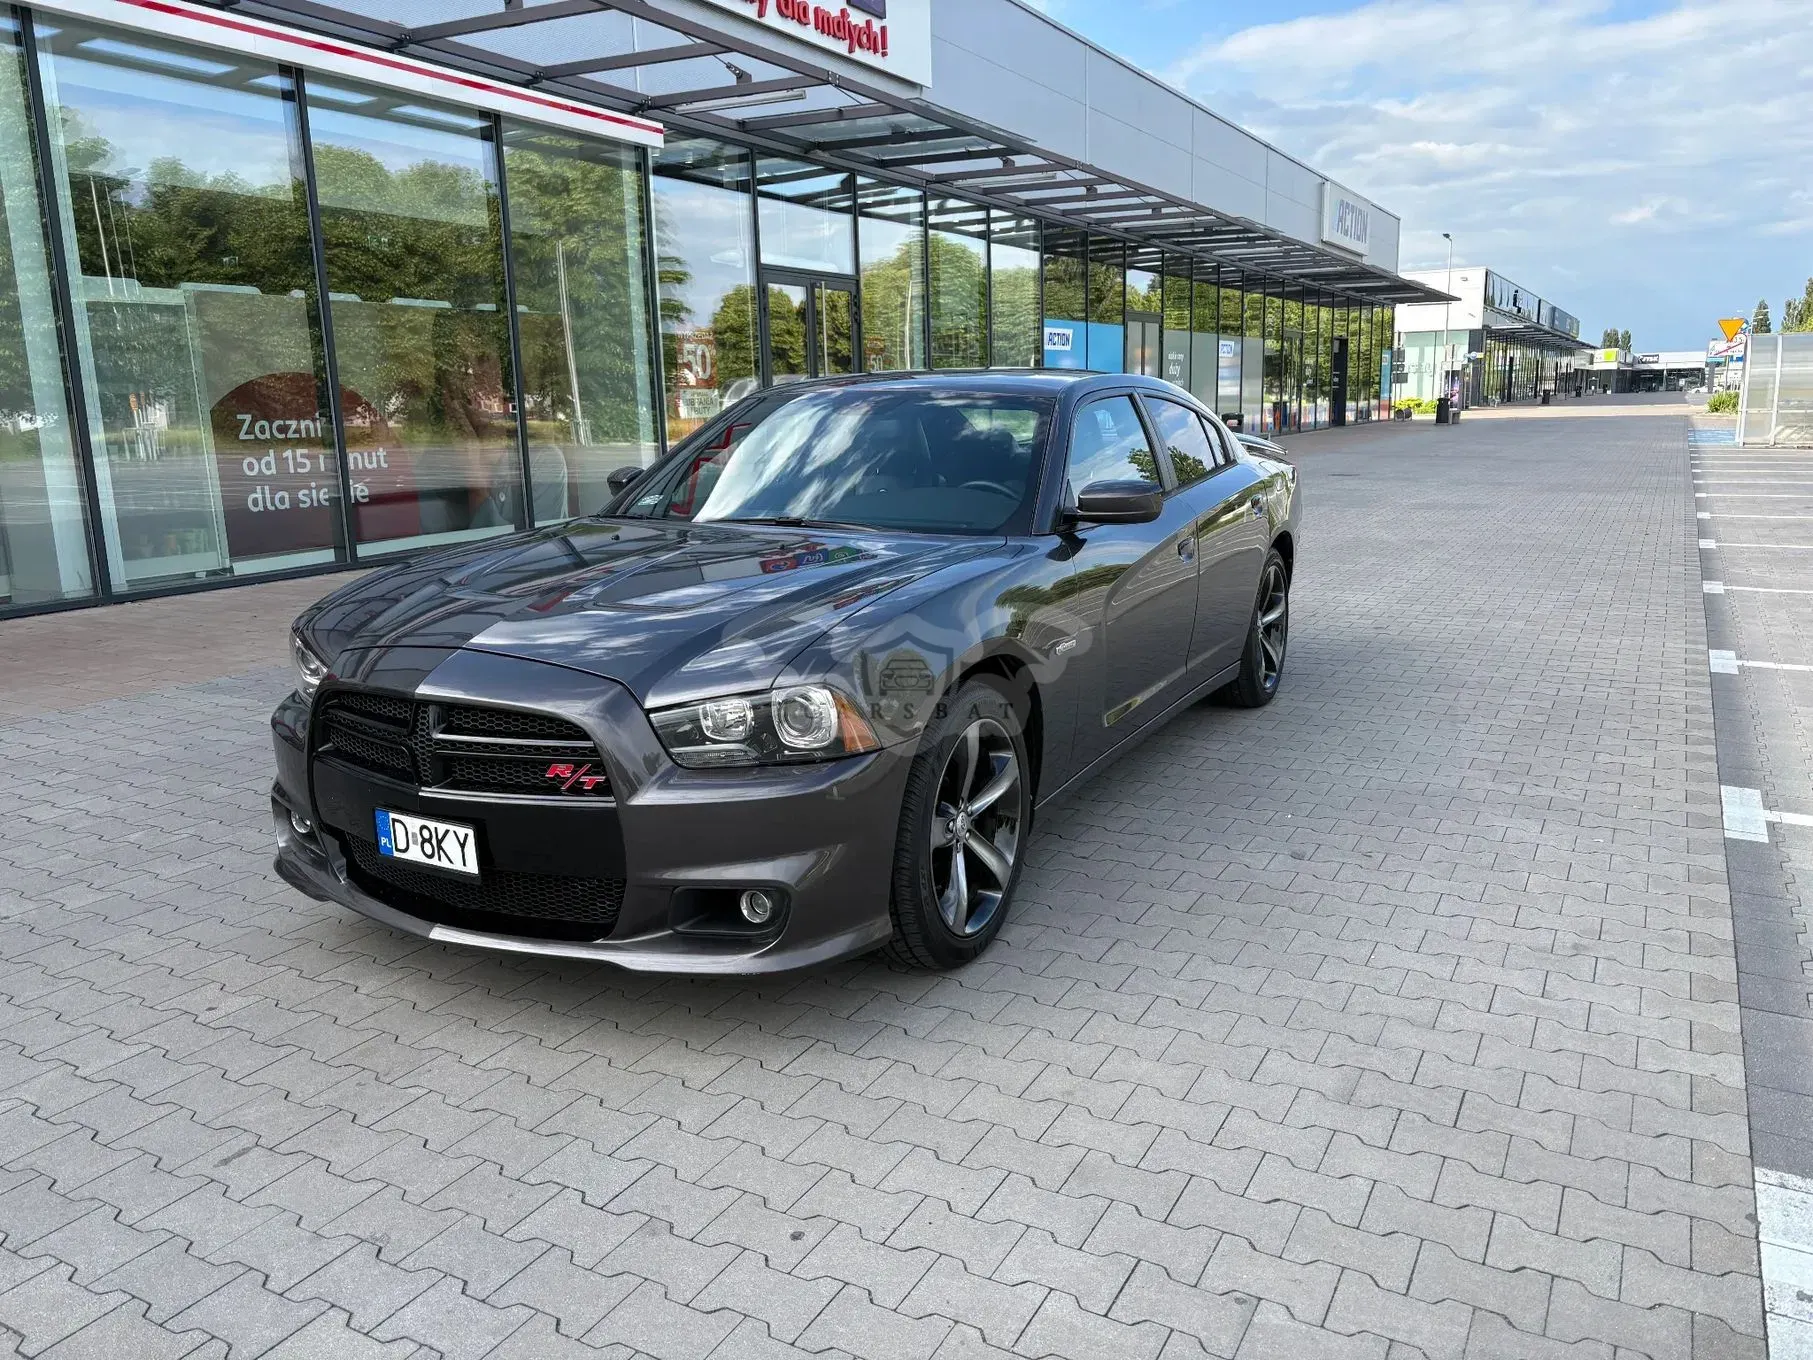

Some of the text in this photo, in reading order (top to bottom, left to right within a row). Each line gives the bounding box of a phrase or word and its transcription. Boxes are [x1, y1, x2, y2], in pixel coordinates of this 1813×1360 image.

[814, 6, 888, 57] małych!
[1336, 199, 1369, 243] ACTION
[1047, 332, 1071, 346] ACTION
[236, 412, 322, 440] Zaczni
[243, 447, 388, 476] od 15 nut
[247, 480, 369, 512] dla sieie
[545, 764, 606, 789] R/T
[381, 836, 391, 848] PL
